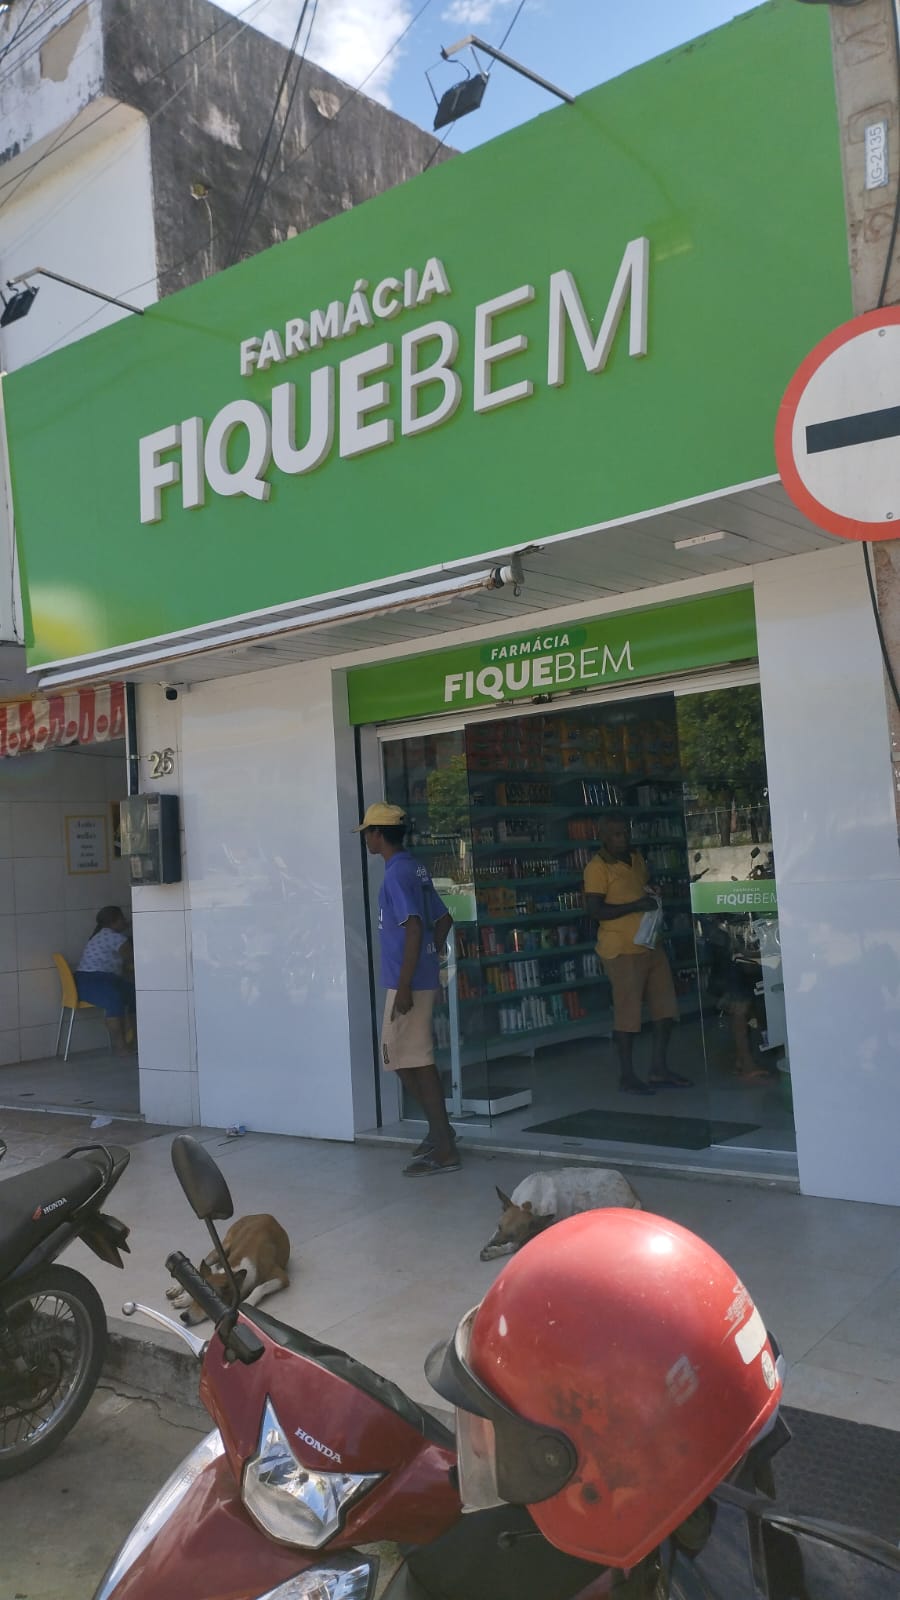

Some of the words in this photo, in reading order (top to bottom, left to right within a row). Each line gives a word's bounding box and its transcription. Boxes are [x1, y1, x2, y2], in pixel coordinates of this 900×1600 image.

[240, 256, 451, 377] FARMÁCIA
[138, 236, 650, 525] FIQUEBEM
[491, 633, 570, 661] FARMÁCIA
[444, 640, 635, 703] FIQUEBEM
[148, 747, 175, 780] 26
[42, 1197, 68, 1215] HONDA
[294, 1427, 342, 1464] HONDA
